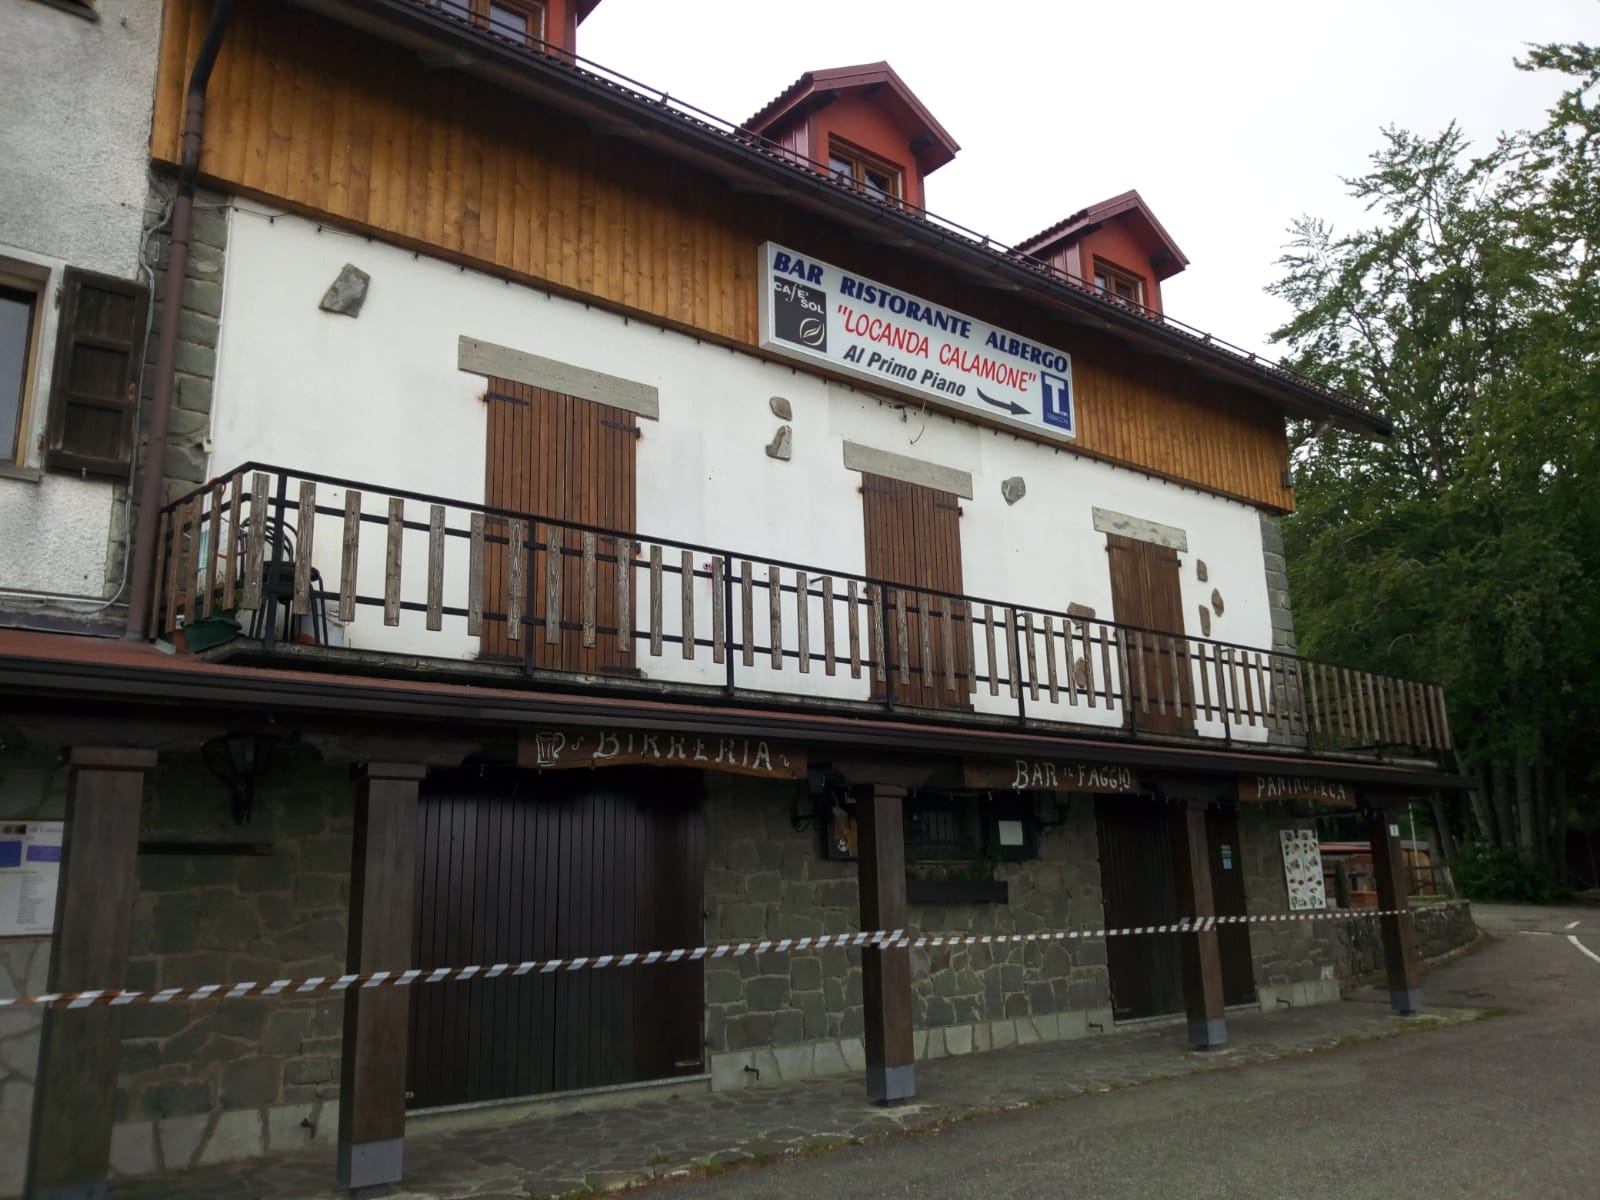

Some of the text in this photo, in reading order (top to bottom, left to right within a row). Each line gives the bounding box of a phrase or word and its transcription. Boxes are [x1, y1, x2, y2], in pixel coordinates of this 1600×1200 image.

[773, 251, 1068, 373] BAR RISTORANTE ALBERGO
[801, 299, 825, 315] SOL
[837, 304, 1037, 392] "LOCANDA CALAMONE"
[843, 344, 967, 398] Al Primo Piano
[1045, 375, 1065, 414] T
[1012, 760, 1059, 790] BAR
